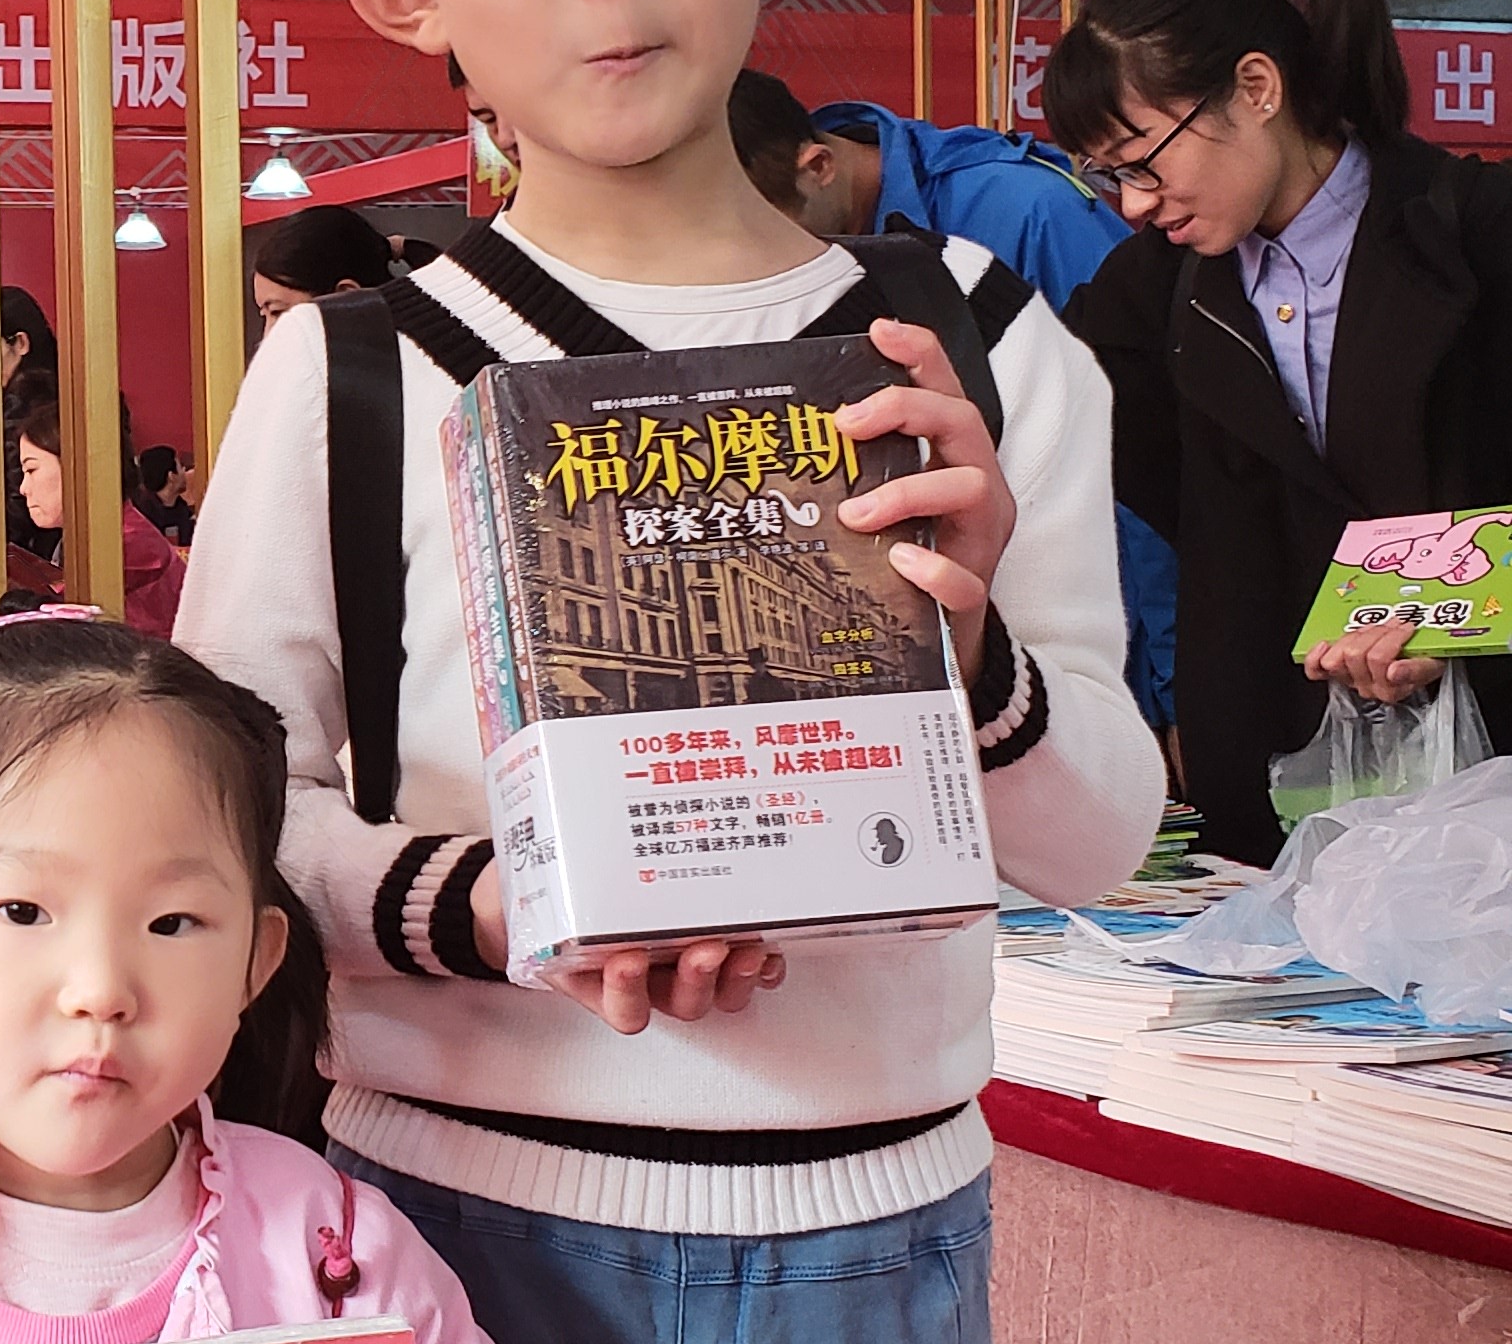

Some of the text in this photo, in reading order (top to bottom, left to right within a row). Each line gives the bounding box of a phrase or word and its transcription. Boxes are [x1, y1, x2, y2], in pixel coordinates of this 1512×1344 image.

[1434, 43, 1495, 125] 出
[545, 402, 860, 514] 福尔摩斯
[624, 496, 783, 546] 探案全集
